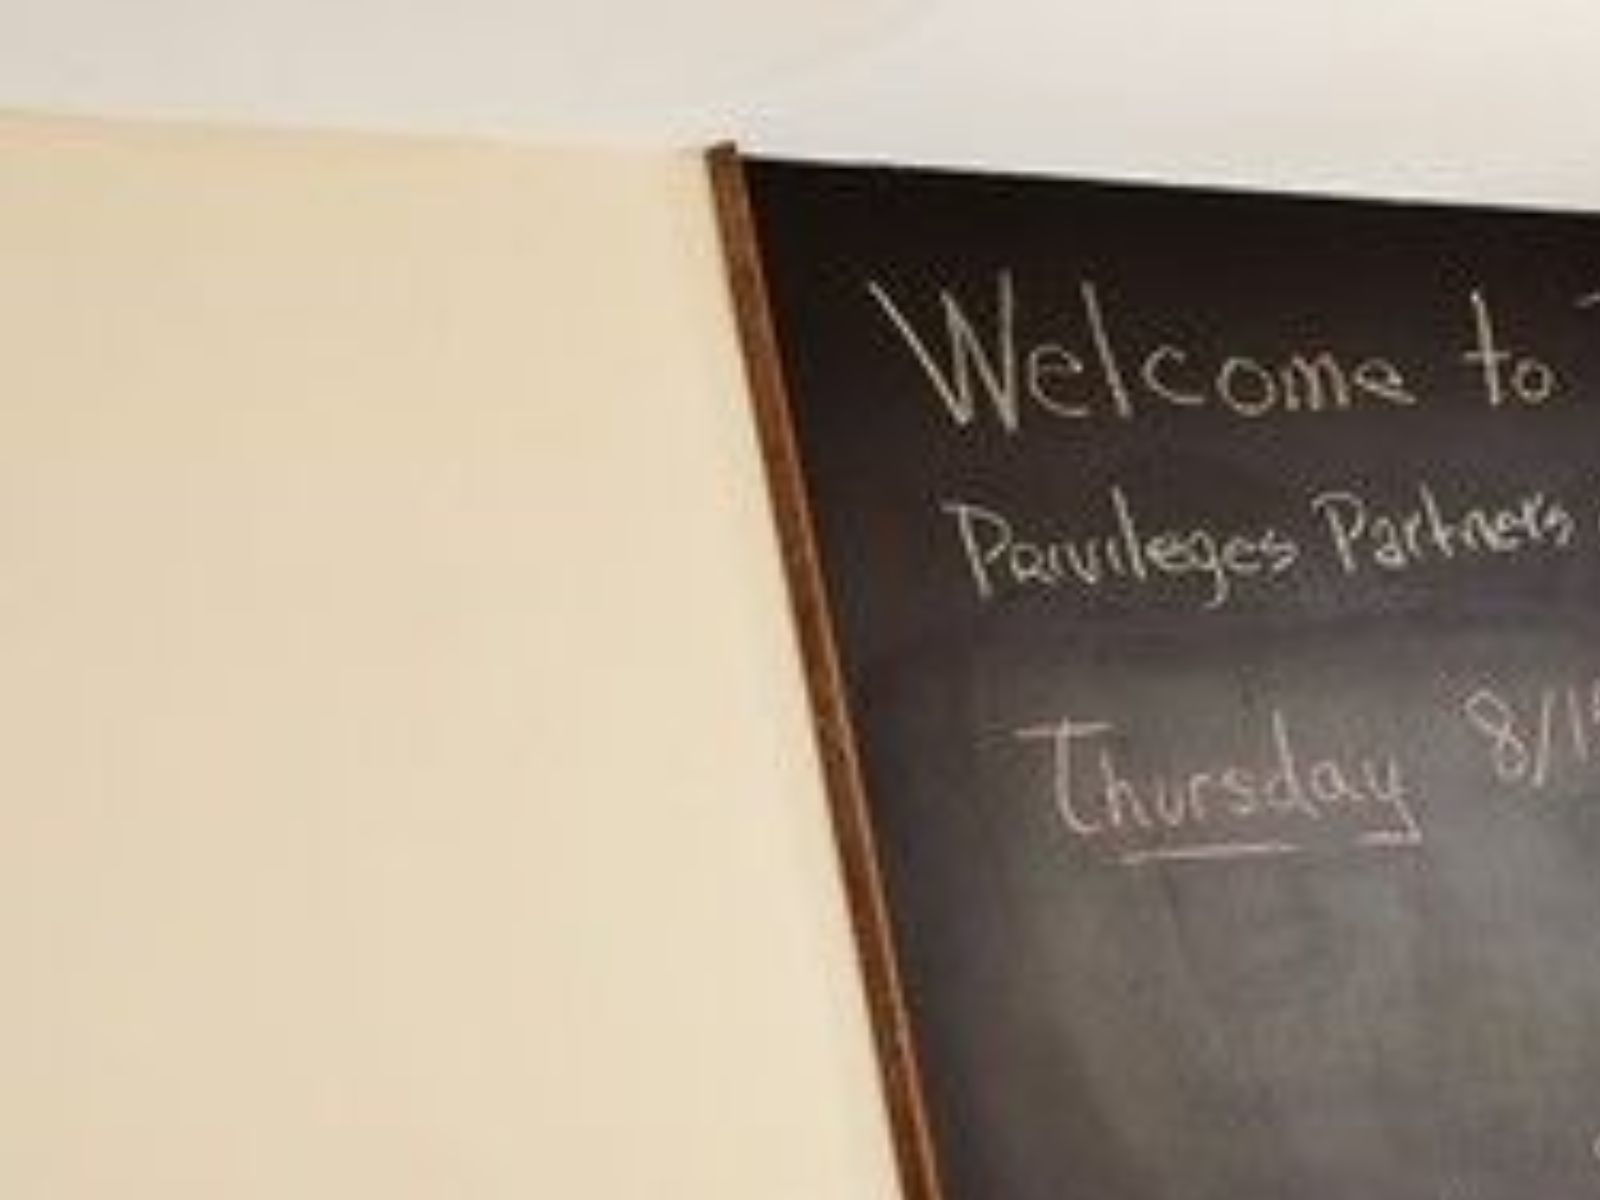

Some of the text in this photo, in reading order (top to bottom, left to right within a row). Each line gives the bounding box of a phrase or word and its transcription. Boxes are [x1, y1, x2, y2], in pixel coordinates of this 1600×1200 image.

[869, 267, 1417, 434] Welcome
[1464, 288, 1554, 408] to
[1013, 708, 1423, 845] Thursday
